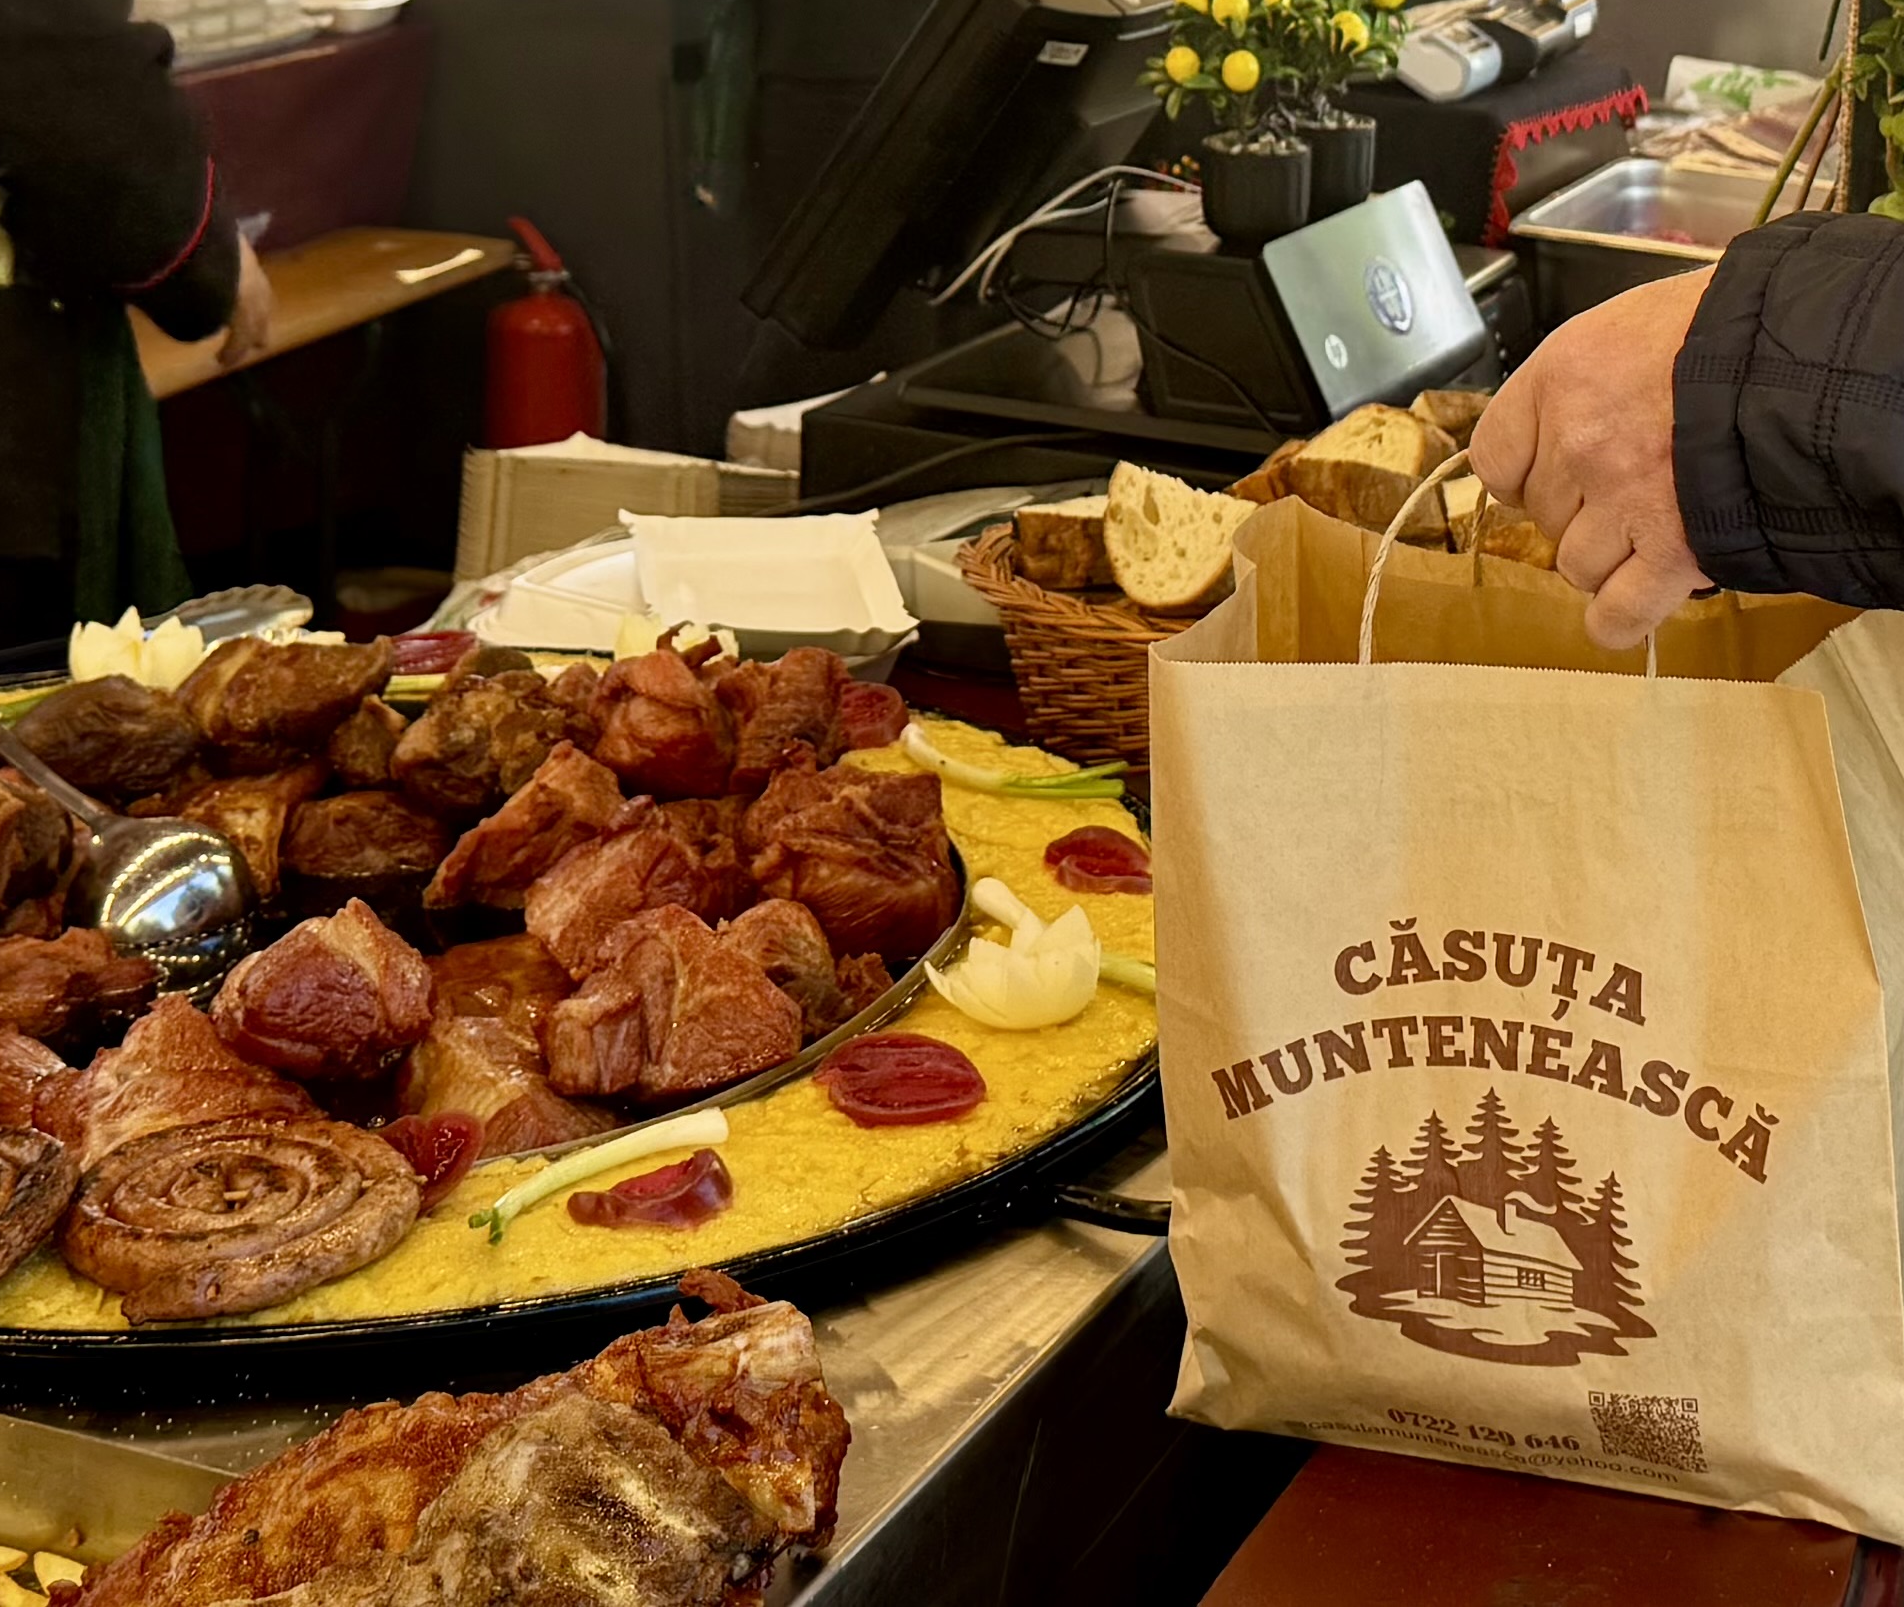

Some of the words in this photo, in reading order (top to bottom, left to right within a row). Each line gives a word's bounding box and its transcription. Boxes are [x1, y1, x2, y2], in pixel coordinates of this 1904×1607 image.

[1334, 917, 1646, 1027] CĂSUȚA
[1211, 1015, 1780, 1185] MUNTENEASCĂ
[1387, 1407, 1460, 1438] 0722
[1467, 1424, 1516, 1447] 120
[1524, 1433, 1581, 1451] 646
